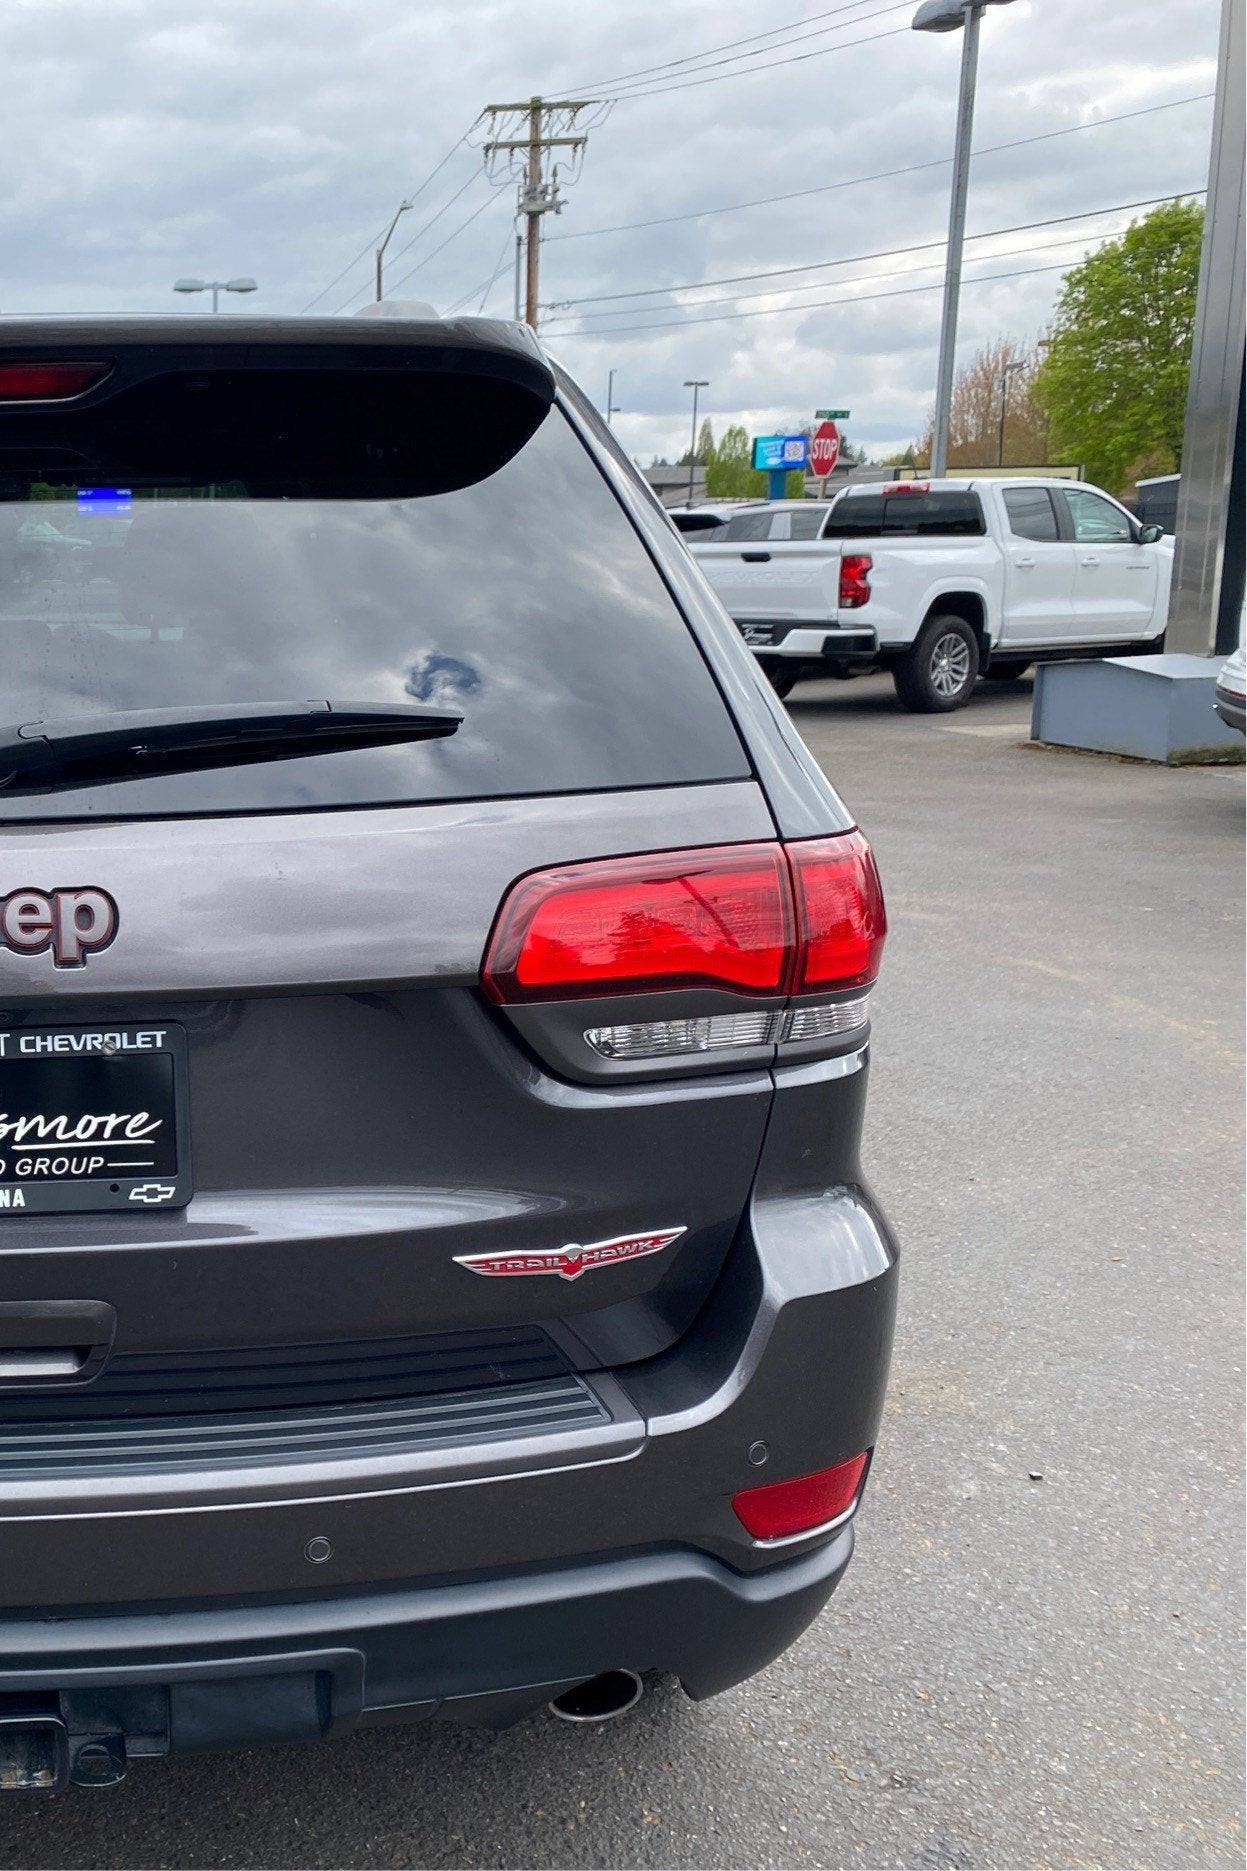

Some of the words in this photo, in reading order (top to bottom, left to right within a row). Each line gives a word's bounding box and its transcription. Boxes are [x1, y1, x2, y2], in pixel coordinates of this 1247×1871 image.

[812, 438, 838, 461] STOP
[19, 1030, 167, 1053] CHEVROLET
[14, 1156, 105, 1176] GROUP
[488, 1255, 567, 1271] TRAIL
[581, 1241, 655, 1264] HAWK
